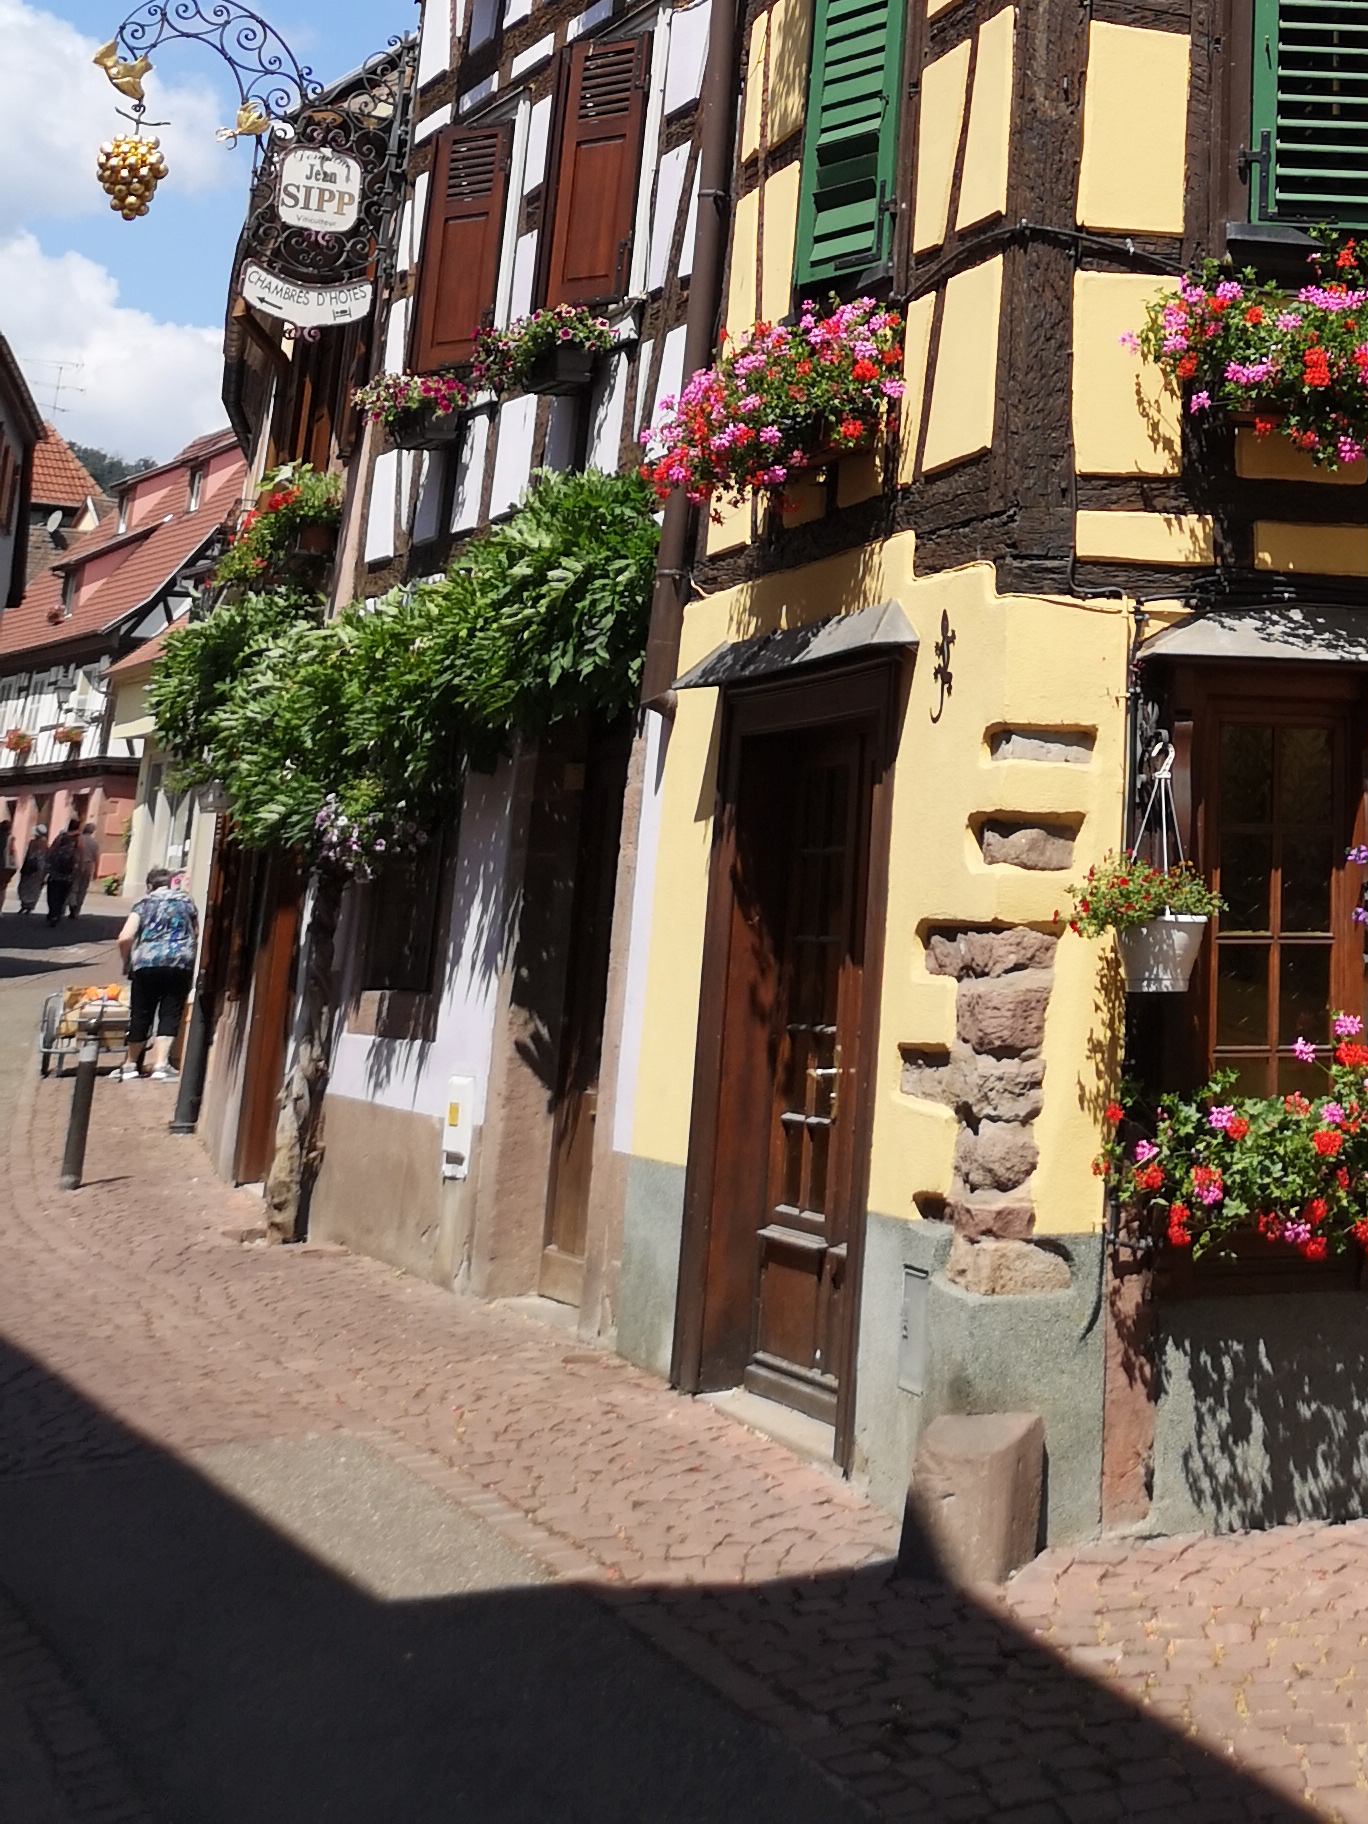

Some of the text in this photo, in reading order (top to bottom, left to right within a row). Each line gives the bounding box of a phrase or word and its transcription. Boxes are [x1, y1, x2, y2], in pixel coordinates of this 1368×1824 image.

[305, 163, 337, 185] Jean
[280, 182, 356, 216] SIPP
[247, 270, 310, 306] CHAMBRES
